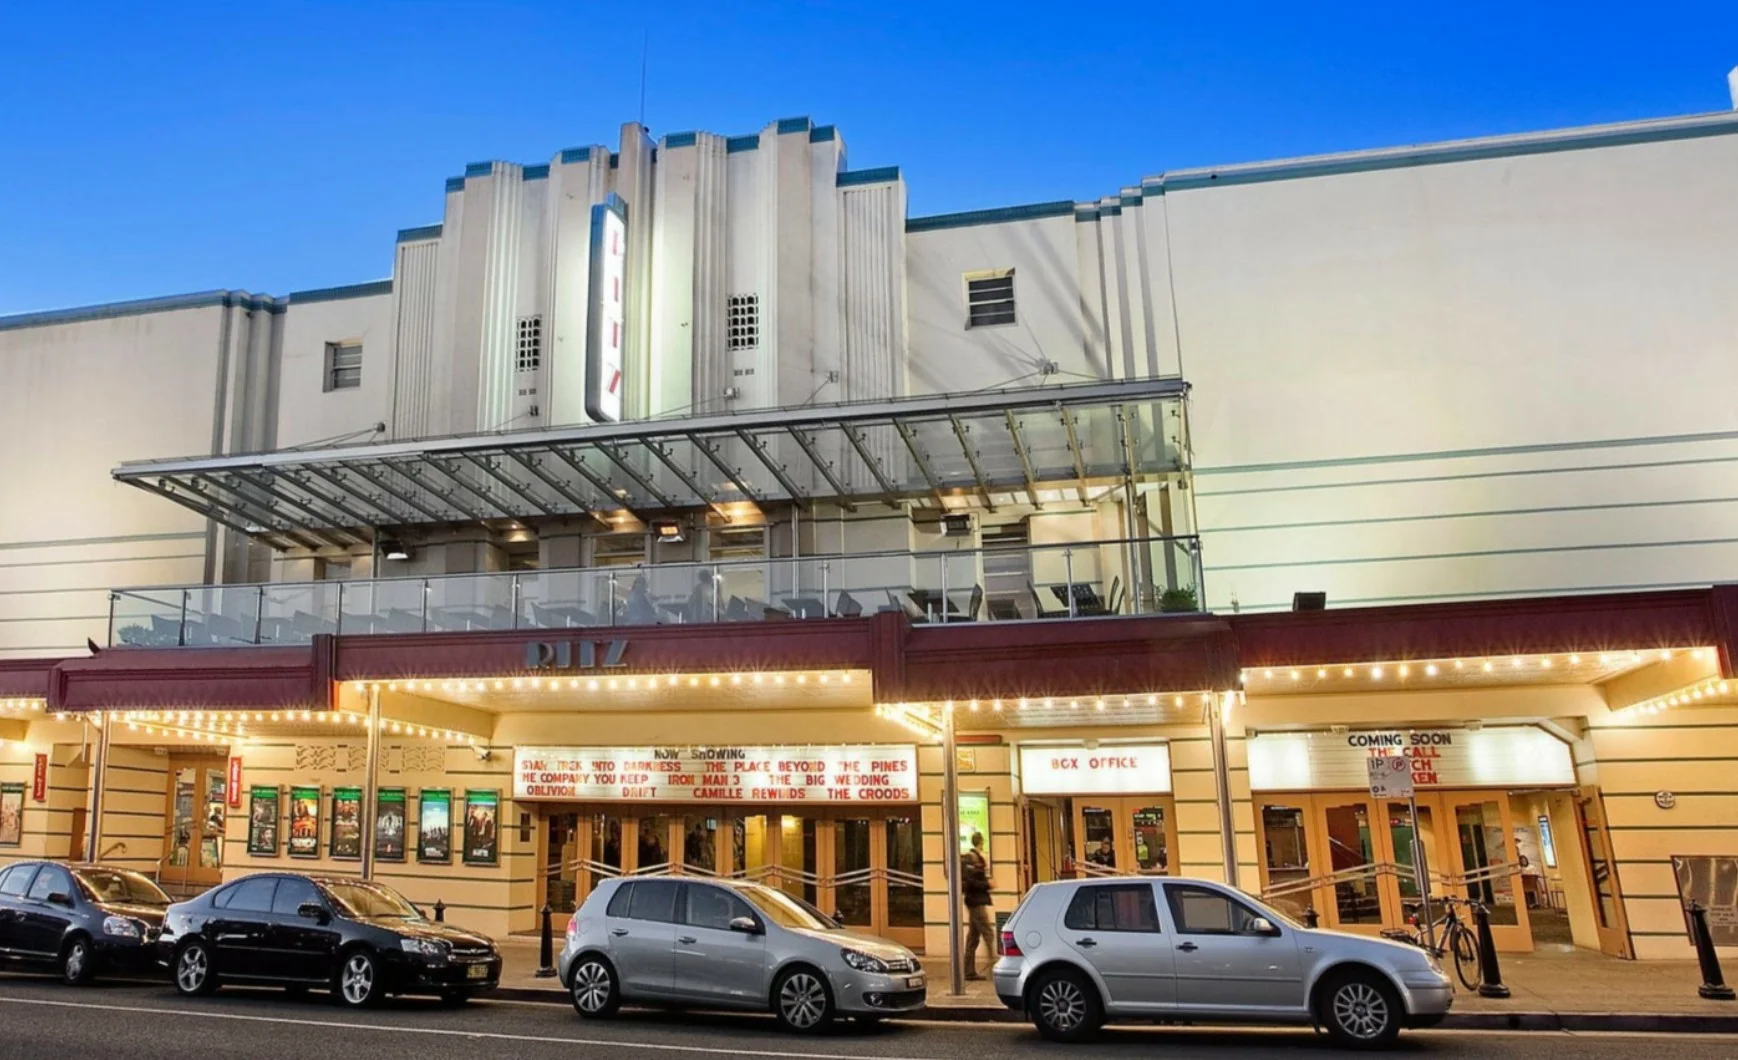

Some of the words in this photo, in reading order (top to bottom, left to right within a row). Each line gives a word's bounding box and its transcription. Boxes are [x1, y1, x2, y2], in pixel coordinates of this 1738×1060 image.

[527, 640, 629, 669] RITZ
[1348, 734, 1402, 747] COMING
[1410, 733, 1452, 745] SOON
[654, 749, 679, 760] NOW
[691, 749, 745, 760] SHOWING
[1402, 746, 1441, 758] CALL
[624, 761, 682, 773] DARKNESS
[704, 761, 727, 772] THE
[734, 761, 770, 772] PLACE
[778, 761, 825, 772] BEYOND
[871, 761, 908, 772] PINES
[1051, 757, 1079, 769] BOX
[1089, 757, 1138, 769] OFFICE
[540, 774, 589, 785] COMPANY
[594, 774, 616, 785] YOU
[620, 774, 649, 785] KEEP
[668, 774, 695, 785] IRON
[702, 774, 728, 786] MAN
[733, 774, 740, 785] 3
[769, 775, 792, 785] THE
[805, 774, 825, 786] BIG
[834, 774, 890, 786] WEDDING
[526, 786, 576, 796] OBLIVION
[622, 786, 657, 798] DRIFT
[693, 787, 743, 799] CAMILLE
[827, 787, 851, 799] THE
[858, 787, 910, 799] CROODS
